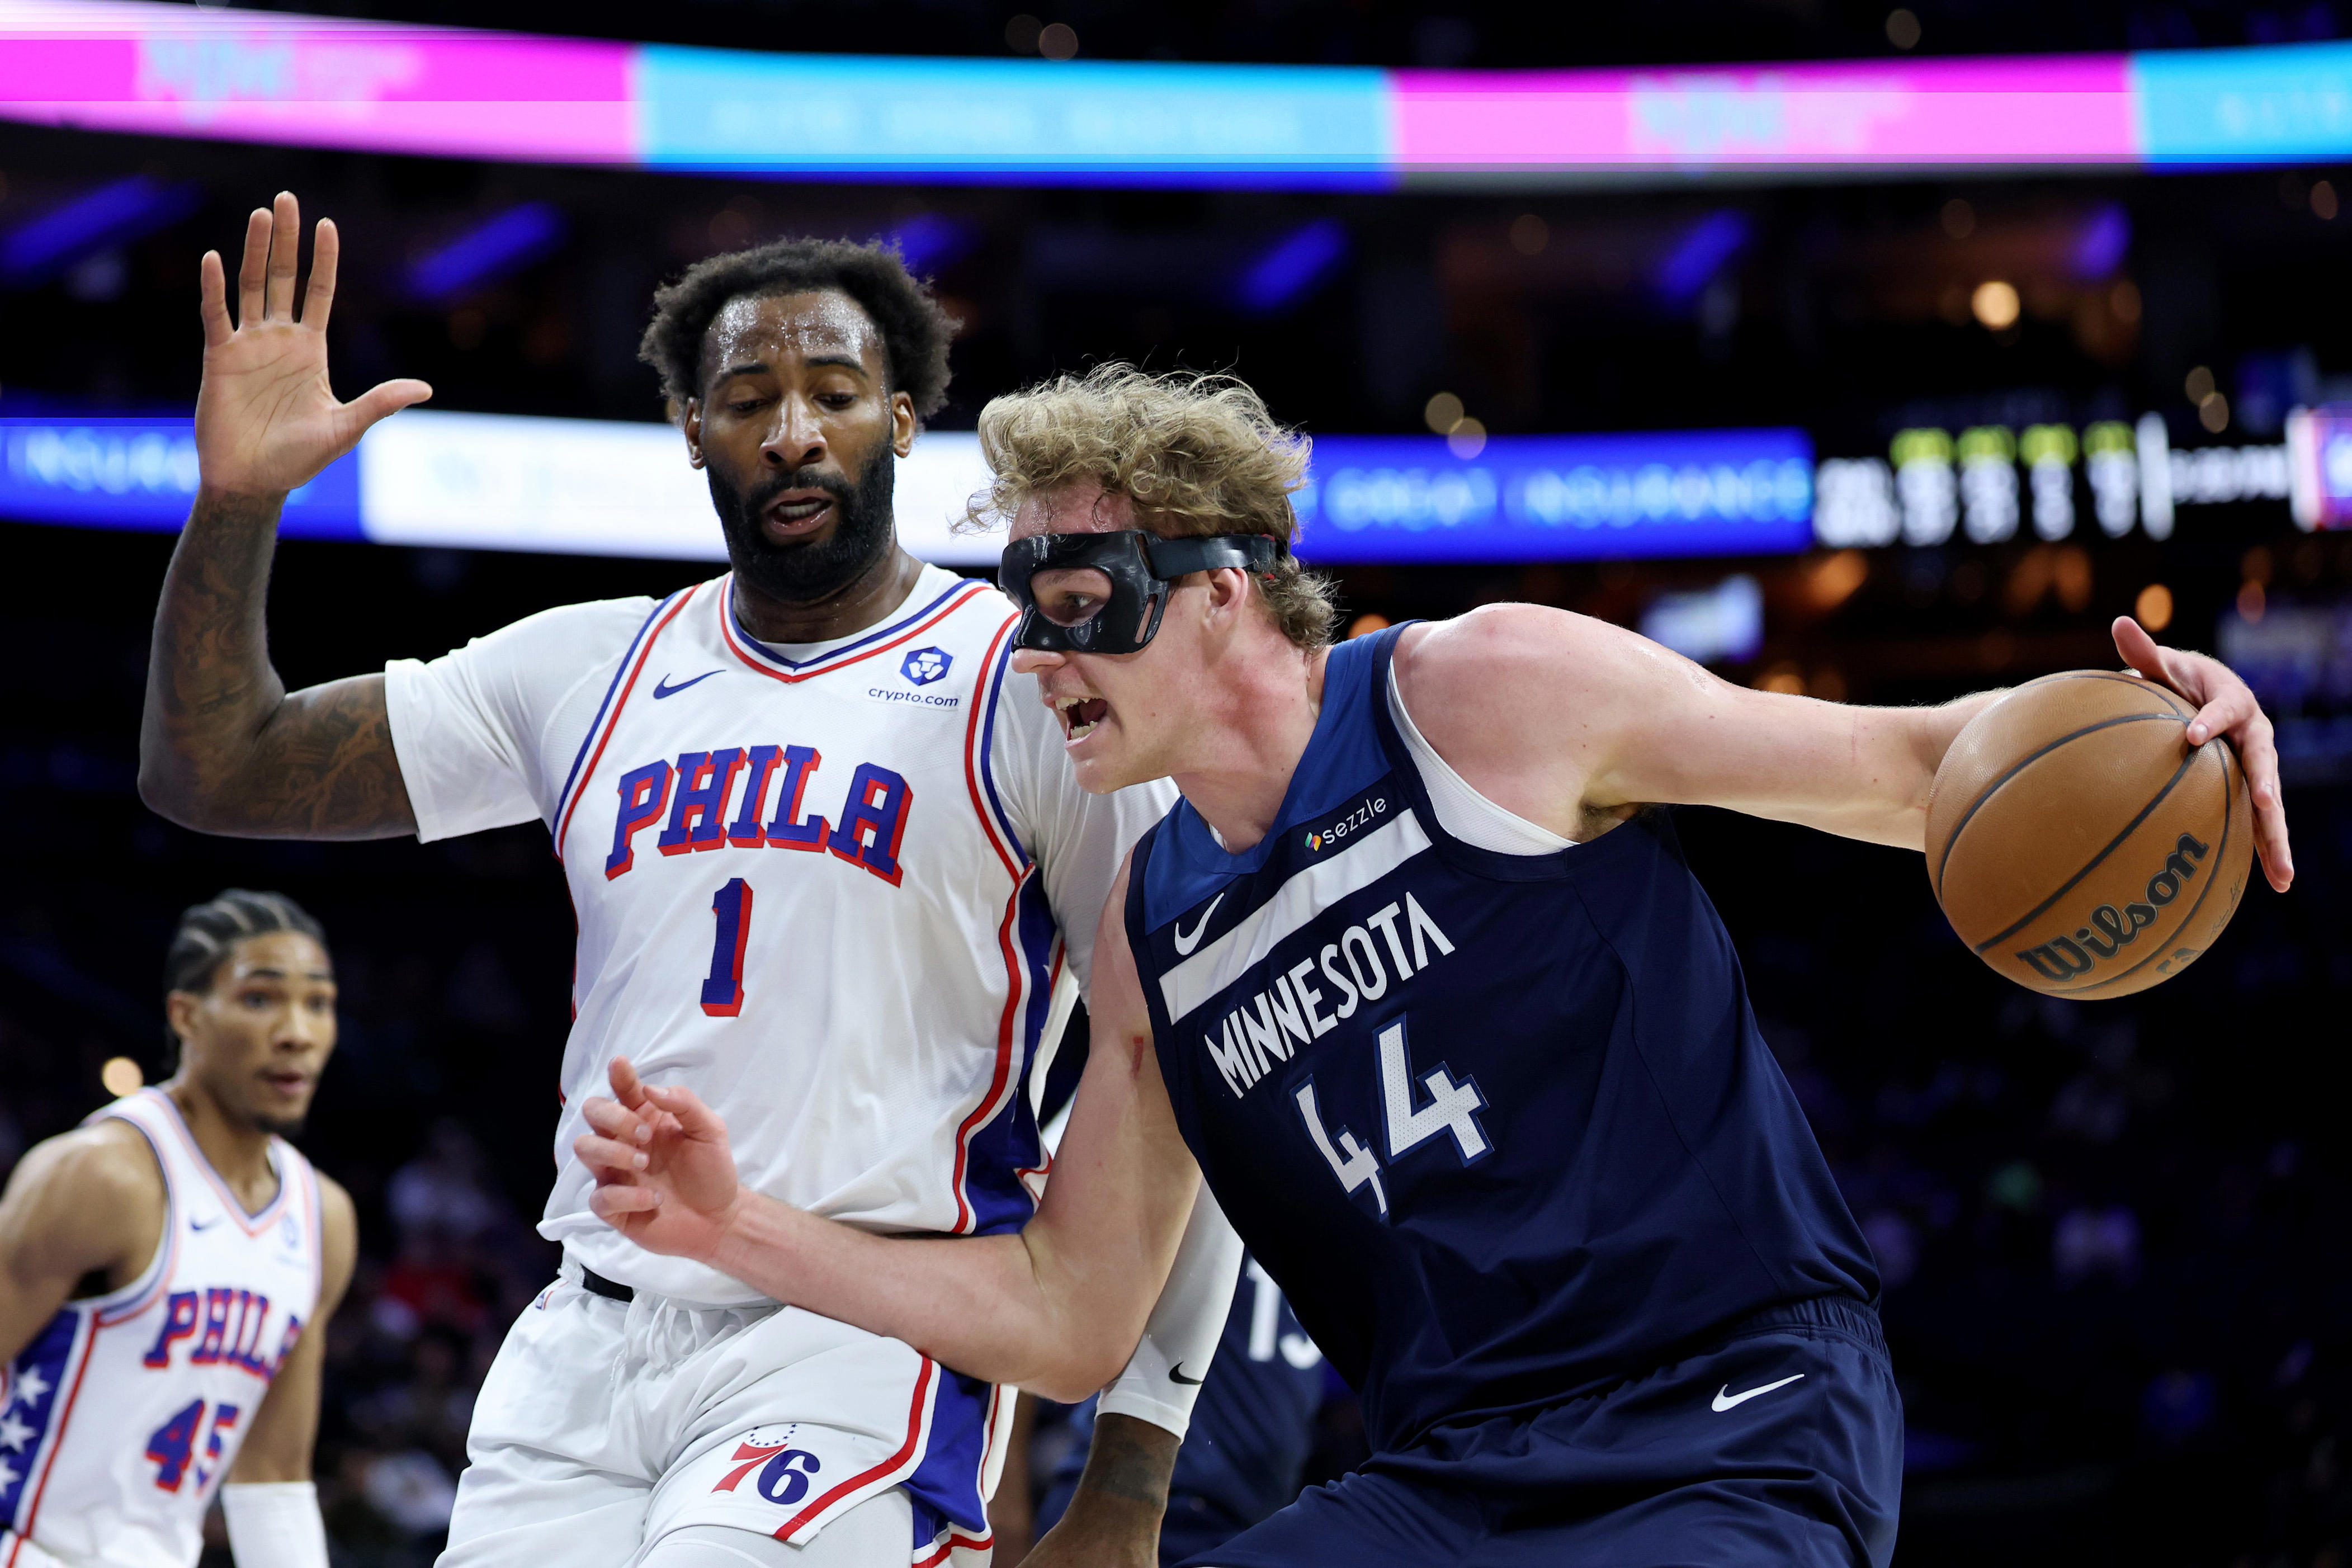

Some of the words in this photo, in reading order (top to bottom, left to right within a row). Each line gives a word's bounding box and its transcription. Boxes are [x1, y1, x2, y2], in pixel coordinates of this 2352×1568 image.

[868, 688, 958, 707] crypto.com
[604, 745, 913, 889] PHILA
[1322, 798, 1386, 844] sezzle
[700, 877, 753, 1017] 1
[2015, 832, 2209, 982] Wilson
[1204, 891, 1455, 1099] MINNESOTA
[1289, 1011, 1495, 1223] 44
[145, 1399, 239, 1498] 45
[710, 1441, 821, 1505] 76
